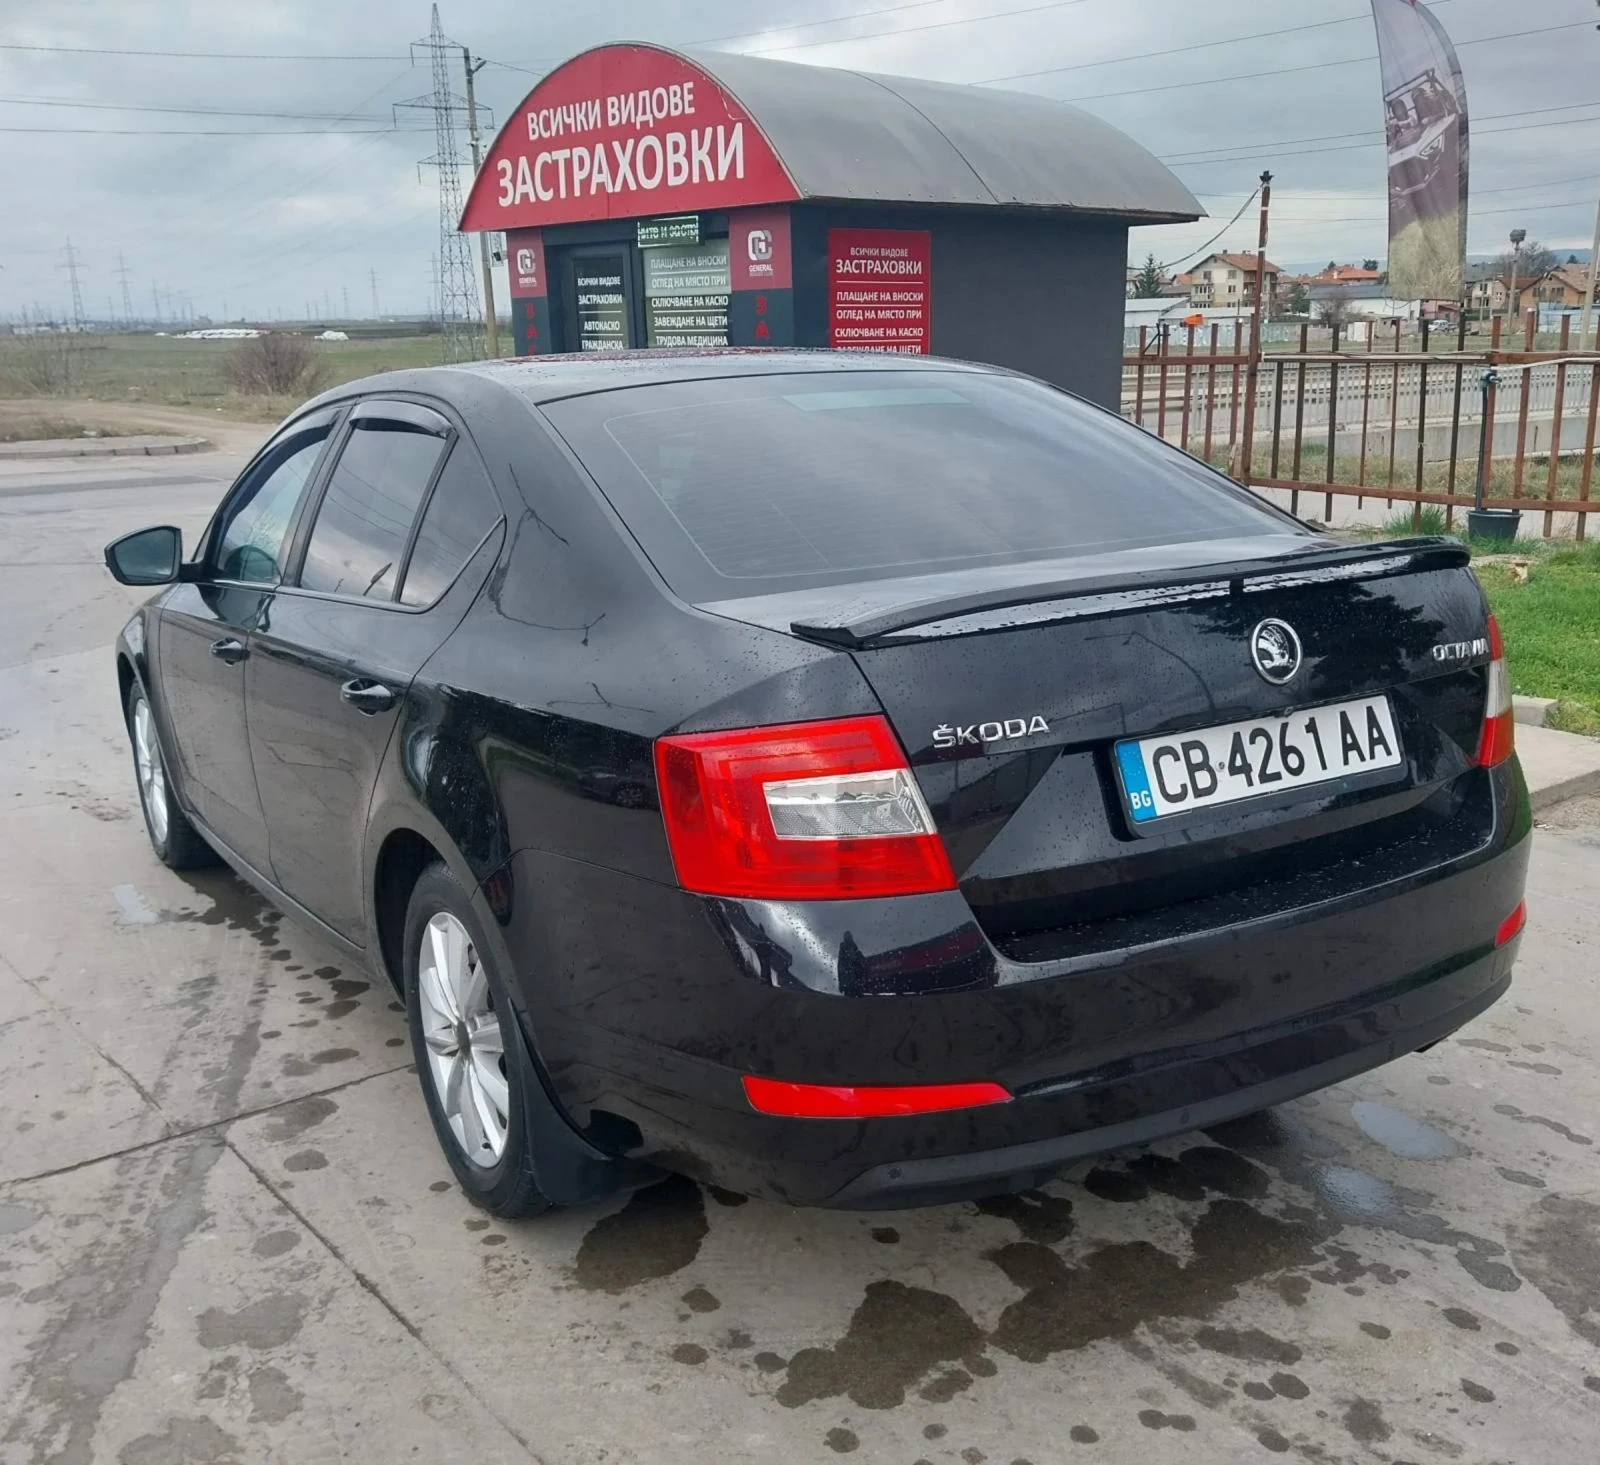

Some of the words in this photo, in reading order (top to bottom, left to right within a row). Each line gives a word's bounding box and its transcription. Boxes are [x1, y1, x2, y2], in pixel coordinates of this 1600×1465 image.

[527, 98, 601, 141] ВСИЧКИ
[607, 81, 695, 130] ВИДОВЕ
[497, 121, 744, 207] ЗАСТРАХОВКИ
[850, 247, 879, 256] ВСИЧКИ
[881, 248, 908, 258] ВИДОВЕ
[651, 258, 685, 270] ПЛАЩАНЕ
[687, 257, 696, 266] НА
[698, 256, 727, 266] ВНОСКИ
[836, 259, 922, 275] ЗАСТРАХОВКИ
[599, 276, 621, 287] ВИДОВЕ
[652, 277, 674, 289] ОГЛЕД
[674, 277, 684, 287] НА
[685, 276, 709, 287] МЯСТО
[711, 275, 726, 286] ПРИ
[578, 294, 623, 305] ЗАСТРАХОВКИ
[652, 296, 693, 307] СКЛЮЧВАНЕ
[694, 296, 704, 306] НА
[705, 295, 728, 306] КАСКО
[837, 291, 878, 302] ПЛАЩАНЕ
[880, 292, 891, 301] НА
[893, 292, 924, 301] ВНОСКИ
[654, 316, 695, 328] ЗАВЕЖДАНЕ
[696, 315, 706, 326] НА
[707, 315, 728, 327] ЩЕТИ
[836, 310, 863, 320] ОГЛЕД
[865, 310, 876, 319] НА
[878, 310, 905, 319] МЯСТО
[906, 310, 922, 319] ПРИ
[584, 320, 620, 331] АВТОКАСКО
[835, 327, 884, 337] СКЛЮЧВАНЕ
[886, 327, 897, 337] НА
[898, 327, 923, 337] КАСКО
[582, 340, 624, 351] ГРАЖДАНСКА
[656, 336, 685, 347] ТРУДОВА
[687, 335, 728, 348] МЕДИЦИНА
[932, 715, 1050, 749] ŠKODA
[1152, 739, 1218, 804] CB
[1227, 716, 1328, 788] 4261
[1339, 705, 1393, 766] AA
[1130, 790, 1152, 810] BG
